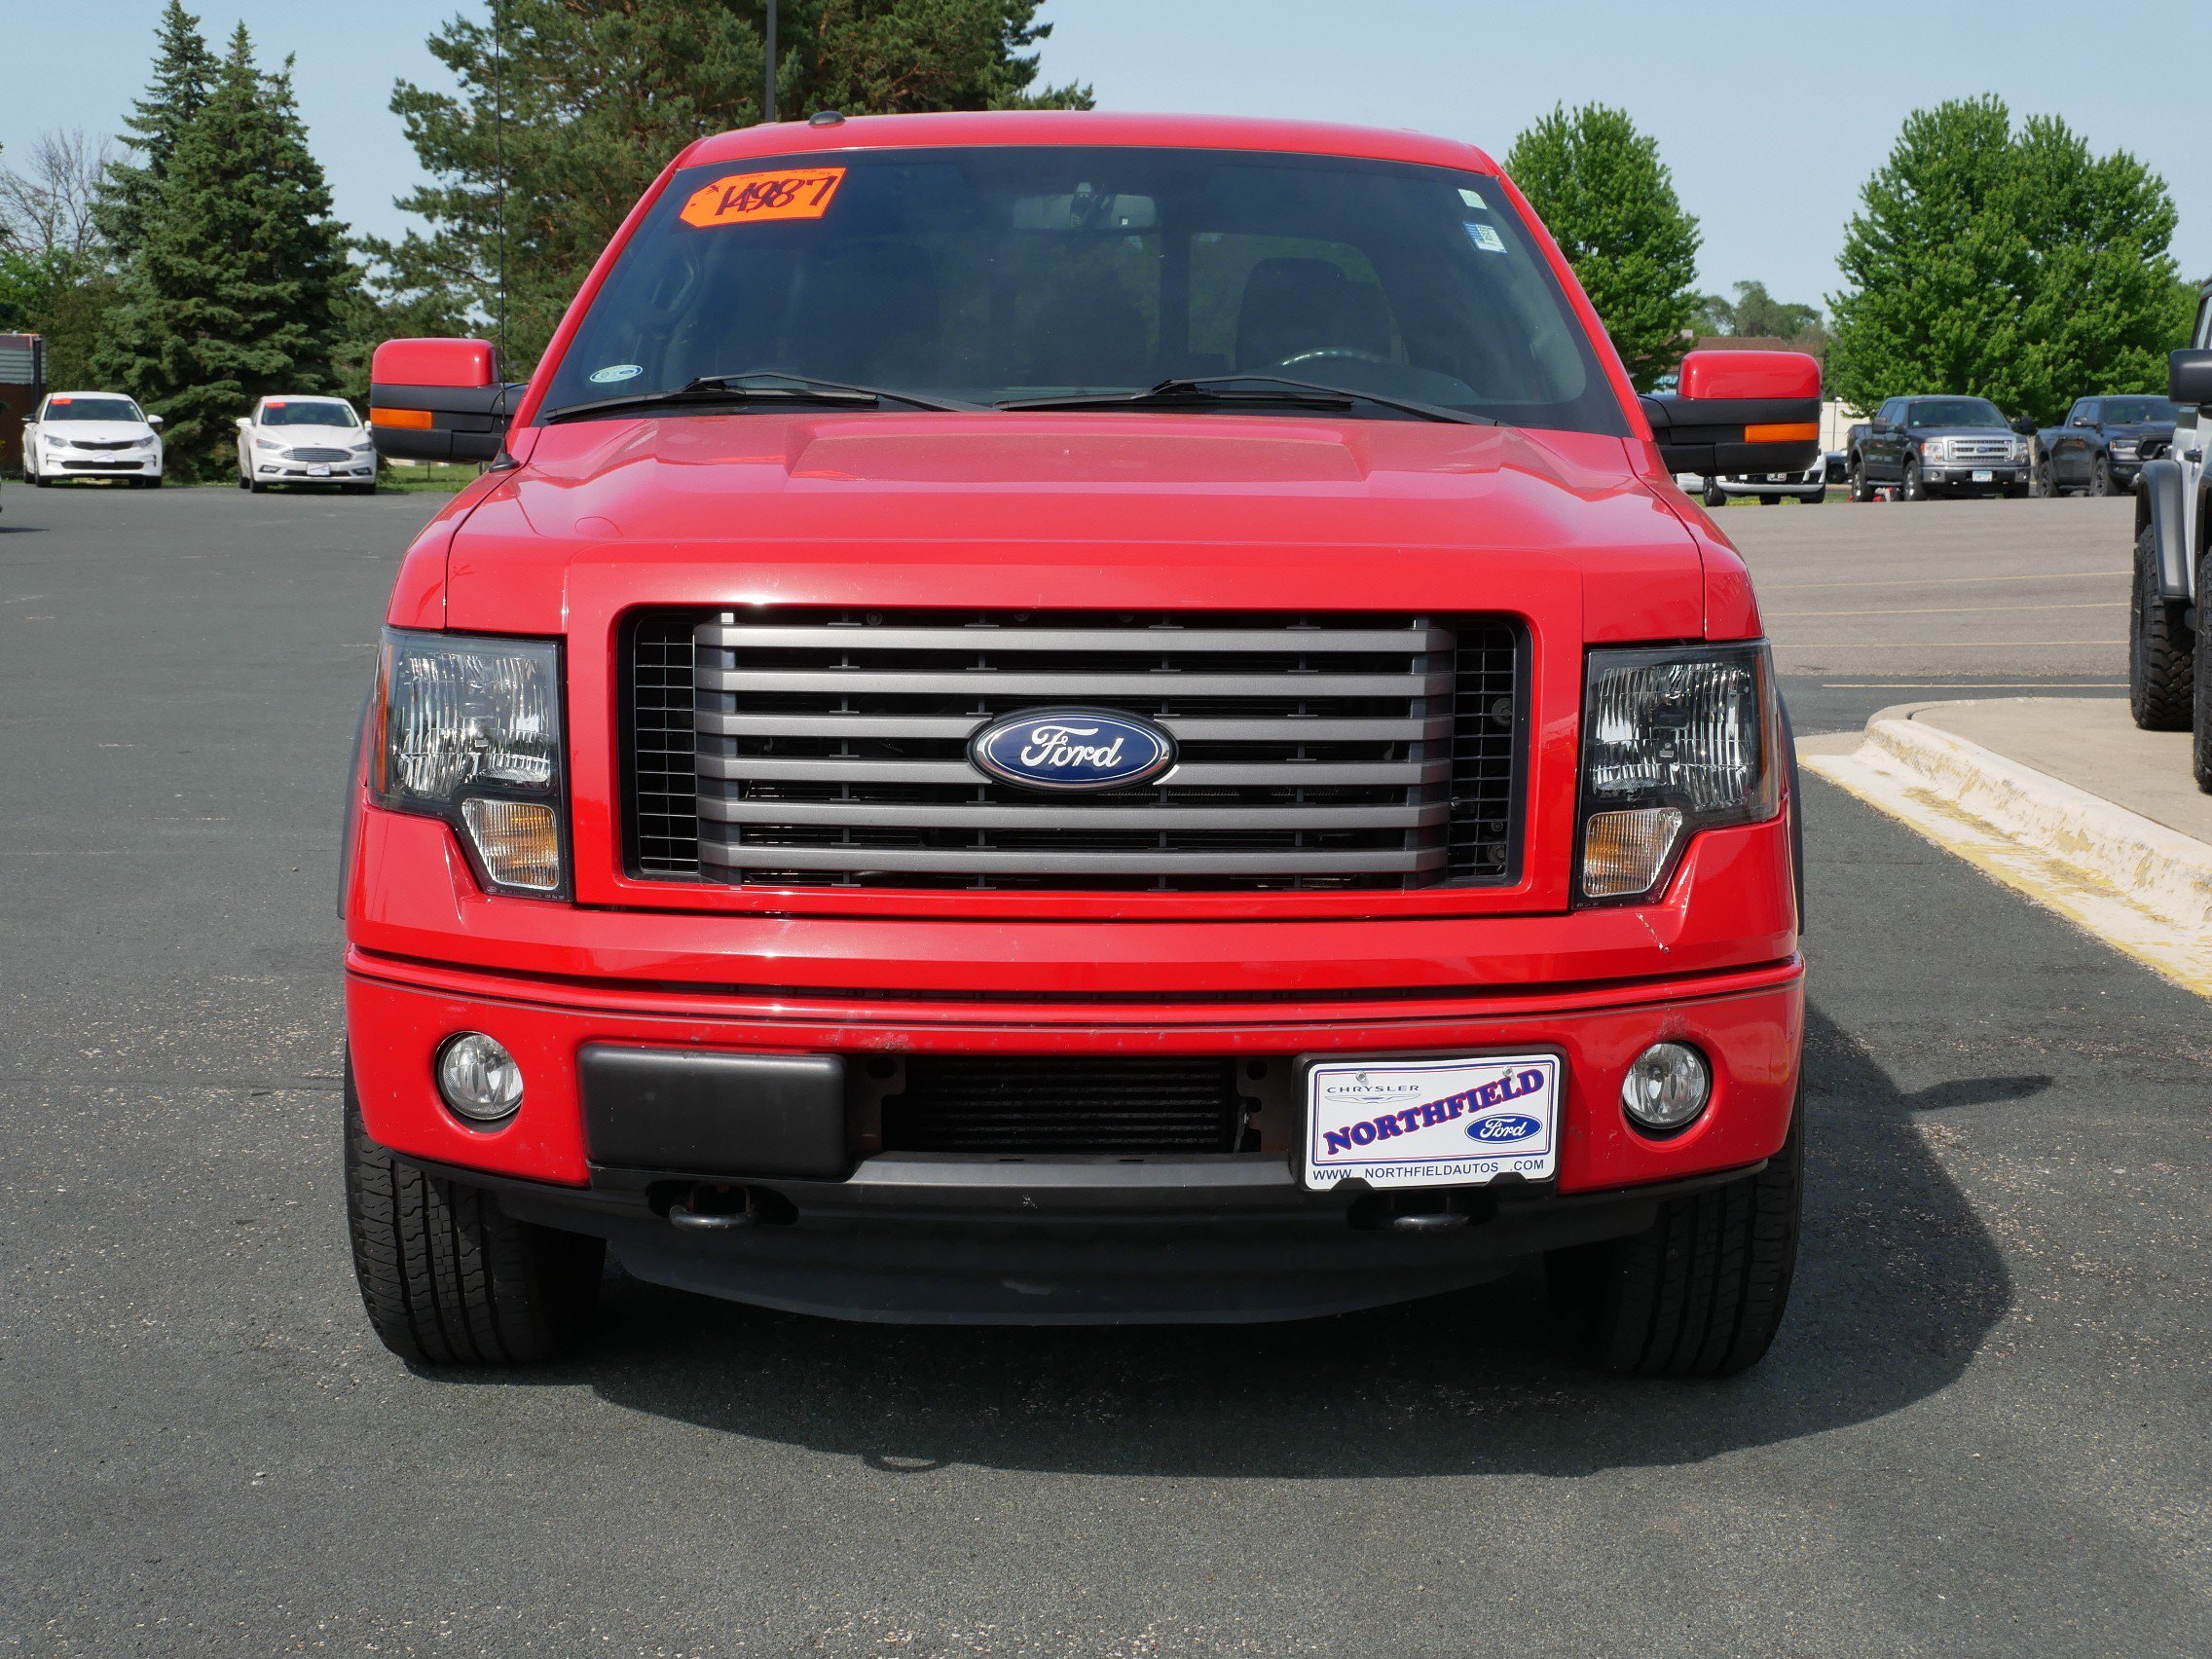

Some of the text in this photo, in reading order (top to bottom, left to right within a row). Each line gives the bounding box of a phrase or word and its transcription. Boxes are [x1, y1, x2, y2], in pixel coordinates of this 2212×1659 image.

[715, 175, 838, 216] 14987
[1020, 725, 1124, 767] Ford
[1327, 1085, 1419, 1093] CHRYSLER
[1323, 1068, 1545, 1156] NORTHFIELD
[1480, 1117, 1527, 1138] Ford
[1365, 1161, 1498, 1179] NORTHFIELDAUTOS
